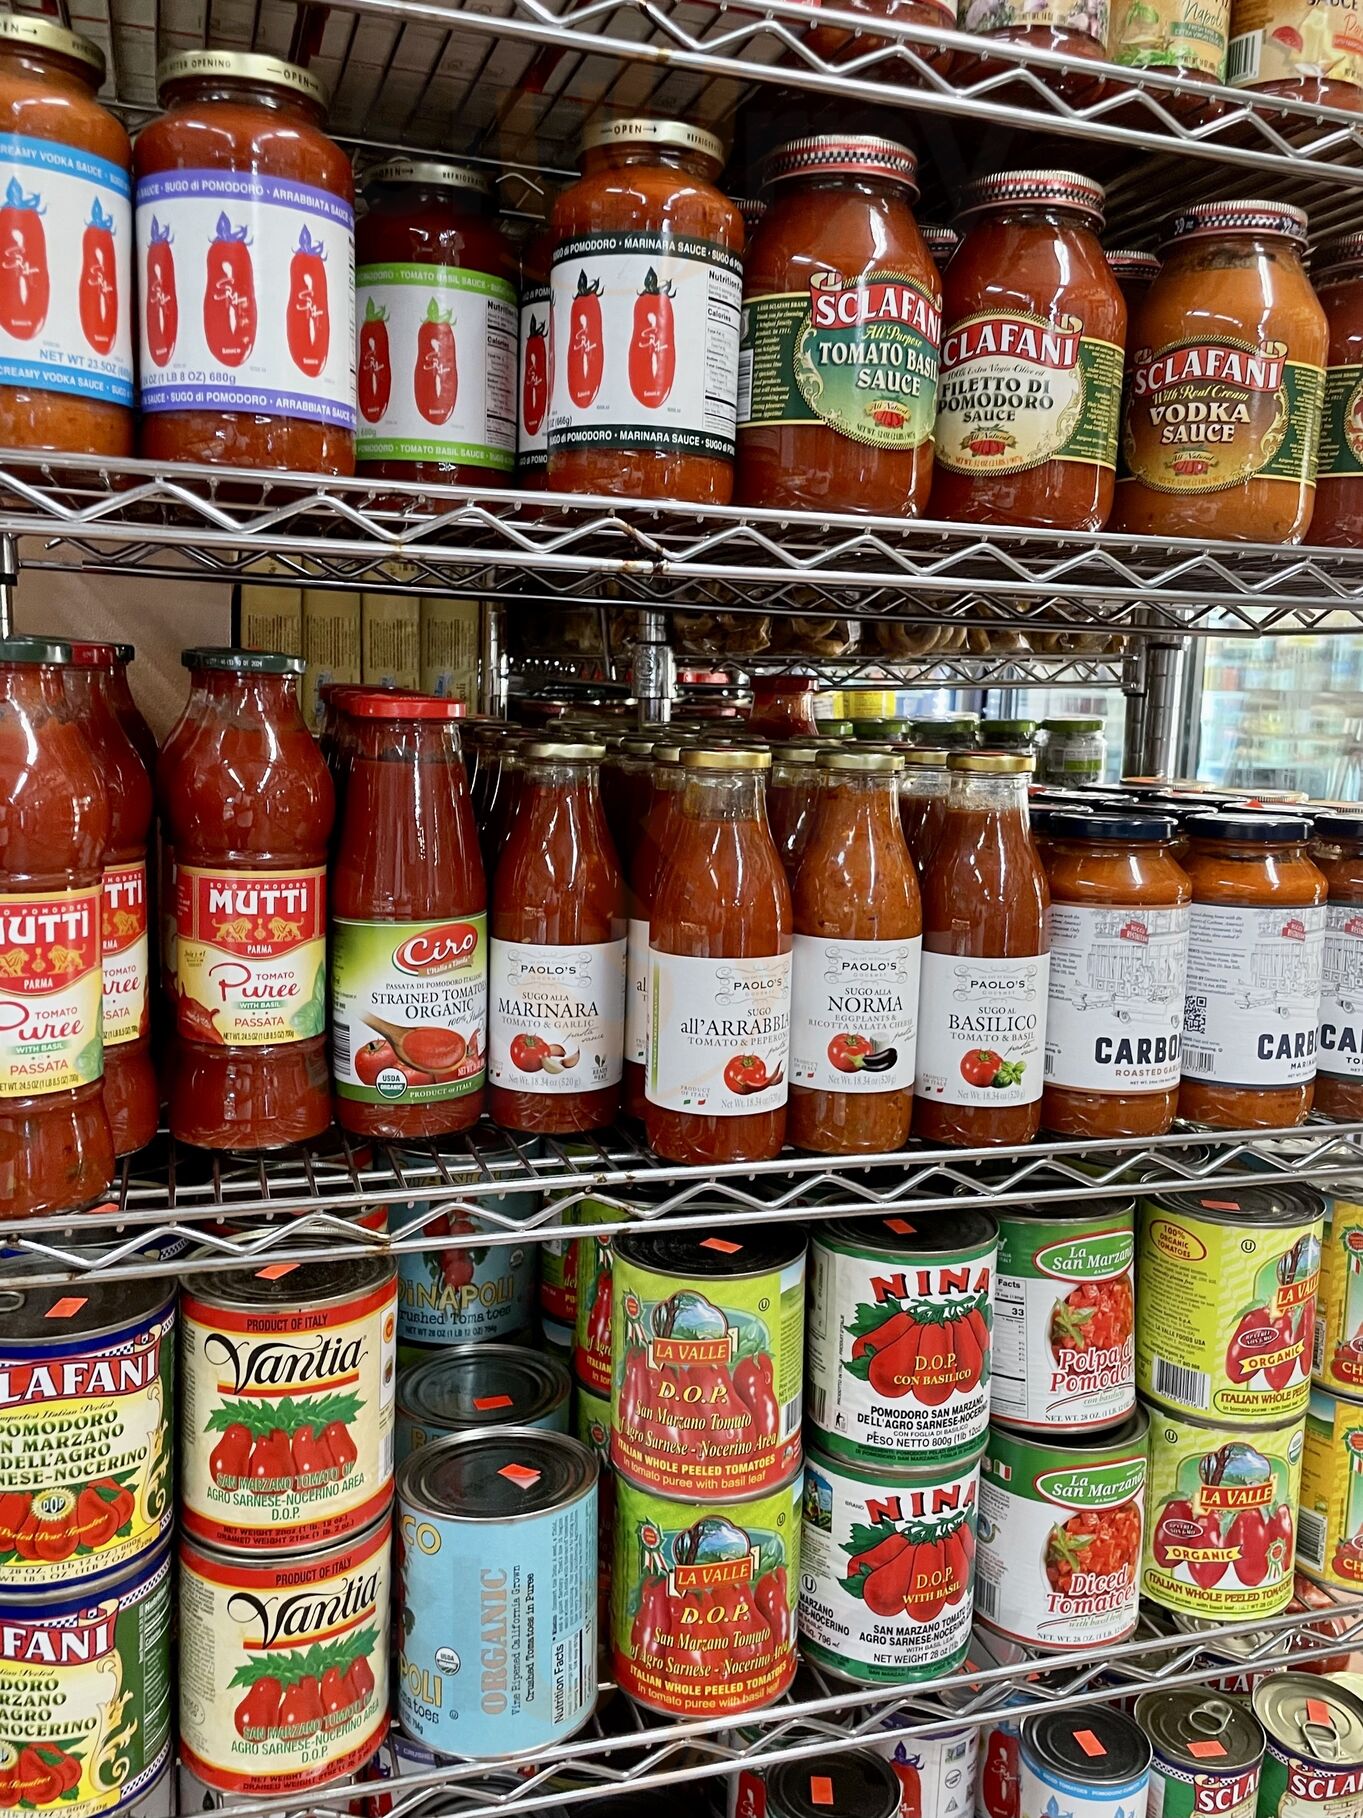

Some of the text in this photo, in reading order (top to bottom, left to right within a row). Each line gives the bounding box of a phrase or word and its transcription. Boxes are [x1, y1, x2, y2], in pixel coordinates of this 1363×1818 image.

[283, 69, 311, 87] OPEN
[614, 124, 642, 135] OPEN
[39, 151, 73, 169] VODKA
[76, 160, 102, 179] SAUCE
[570, 239, 616, 252] POMODORO
[625, 238, 675, 250] MARINARA
[678, 242, 706, 256] SAUCE
[707, 308, 731, 322] Calories
[816, 288, 941, 344] SCLAFANI
[862, 325, 923, 347] All Purpose
[943, 324, 1074, 367] CLAFANI
[40, 349, 64, 361] NET
[67, 354, 86, 365] WT
[820, 342, 938, 382] TOMATO BASIL
[1135, 349, 1279, 395] SCLAFANI
[856, 368, 921, 397] SAUCE
[943, 377, 1050, 398] FILETTO DI
[939, 392, 1054, 414] POMODORO
[1152, 385, 1250, 405] With Real Cream
[963, 410, 1015, 423] SAUCE
[1150, 403, 1251, 425] VODKA
[1161, 424, 1235, 444] SAUCE
[246, 882, 307, 890] POMODORO
[209, 887, 307, 915] MUTTI
[247, 945, 272, 954] PARMA
[403, 933, 473, 967] Ciro
[521, 965, 576, 975] PAOLO'S
[842, 962, 897, 971] PAOLO'S
[24, 977, 53, 990] PARMA
[209, 962, 300, 1002] Puree TOMATO
[386, 982, 416, 990] PASSATA
[425, 978, 462, 989] POMODORO
[970, 980, 1025, 989] PAOLO'S
[371, 982, 487, 1005] STRAINED TOMATO
[522, 992, 549, 1000] SUGO
[35, 1007, 78, 1019] TOMATO
[405, 998, 473, 1019] ORGANIC
[499, 998, 599, 1018] MARINARA
[747, 1007, 771, 1017] SUGO
[827, 996, 903, 1012] NORMA
[234, 1016, 284, 1028] PASSATA
[502, 1018, 594, 1029] TOMATO & GARLIC
[808, 1019, 849, 1030] RICOTTA
[853, 1022, 887, 1030] SALATA
[949, 1014, 1037, 1032] BASILICO
[951, 1032, 999, 1042] TOMATO
[1012, 1033, 1034, 1041] BASIL
[16, 1041, 64, 1054] WITH BASIL
[1095, 1032, 1182, 1065] CARBO
[10, 1060, 69, 1076] PASSATA
[1115, 1069, 1162, 1077] ROASTED
[382, 1074, 400, 1082] USDA
[410, 1082, 473, 1098] PRODUCT ITALY
[1160, 1233, 1188, 1249] ORGANIC
[1164, 1225, 1186, 1240] 100%
[1069, 1246, 1086, 1258] La
[1158, 1239, 1190, 1258] TOMATOES
[1052, 1257, 1083, 1271] San
[869, 1267, 990, 1303] NINA
[997, 1279, 1021, 1289] Facts
[399, 1306, 511, 1324] rushed Tomatoes
[1012, 1308, 1024, 1316] 33
[247, 1314, 328, 1330] PRODUCT OF ITALY
[656, 1344, 727, 1360] LA VALLE
[1059, 1345, 1120, 1370] Polpa
[1248, 1345, 1300, 1369] ORGANIC
[204, 1333, 368, 1395] Vantia
[915, 1353, 957, 1371] D.O.P.
[0, 1349, 158, 1402] LAFANI
[893, 1369, 971, 1385] CON BASILICO
[658, 1381, 728, 1404] D.O.P.
[635, 1400, 752, 1431] San Marzano Tomato
[871, 1394, 984, 1421] POMODORO SAN MARZANO
[22, 1423, 124, 1451] MARZANO
[1, 1442, 112, 1469] DELL'AGRO
[618, 1438, 776, 1476] ITALIAN WHOLE PEELED TOMATOES
[207, 1472, 365, 1508] AGRO SARNESE-NOCERINO AREA
[1052, 1472, 1142, 1497] San Marzano
[1070, 1475, 1088, 1486] La
[865, 1481, 976, 1525] NINA
[1202, 1487, 1272, 1505] LA VALLE
[271, 1507, 300, 1521] D.O.P.
[1172, 1548, 1234, 1560] ORGANIC
[275, 1557, 352, 1586] PRODUCT OF ITALY
[678, 1563, 749, 1585] LA VALLE
[916, 1567, 954, 1589] D.O.P.
[1071, 1563, 1127, 1595] Diced
[1047, 1582, 1136, 1615] Tomatoes
[227, 1571, 382, 1650] Vantia
[874, 1624, 894, 1635] SAN
[896, 1619, 940, 1636] MARZANO
[2, 1622, 109, 1663] FANI
[480, 1567, 507, 1716] ORGANIC
[511, 1565, 521, 1716] Vine Ripened California Grown
[526, 1572, 535, 1703] Crushed Tomatoes in Puree
[859, 1631, 886, 1646] AGRO
[440, 1653, 455, 1661] USDA
[554, 1644, 564, 1724] Nutrition Facts
[630, 1662, 787, 1696] ITALIAN WHOLE PEELED TOMATOES
[231, 1697, 379, 1756] AGRO SARNESE-NOCERINO AREA
